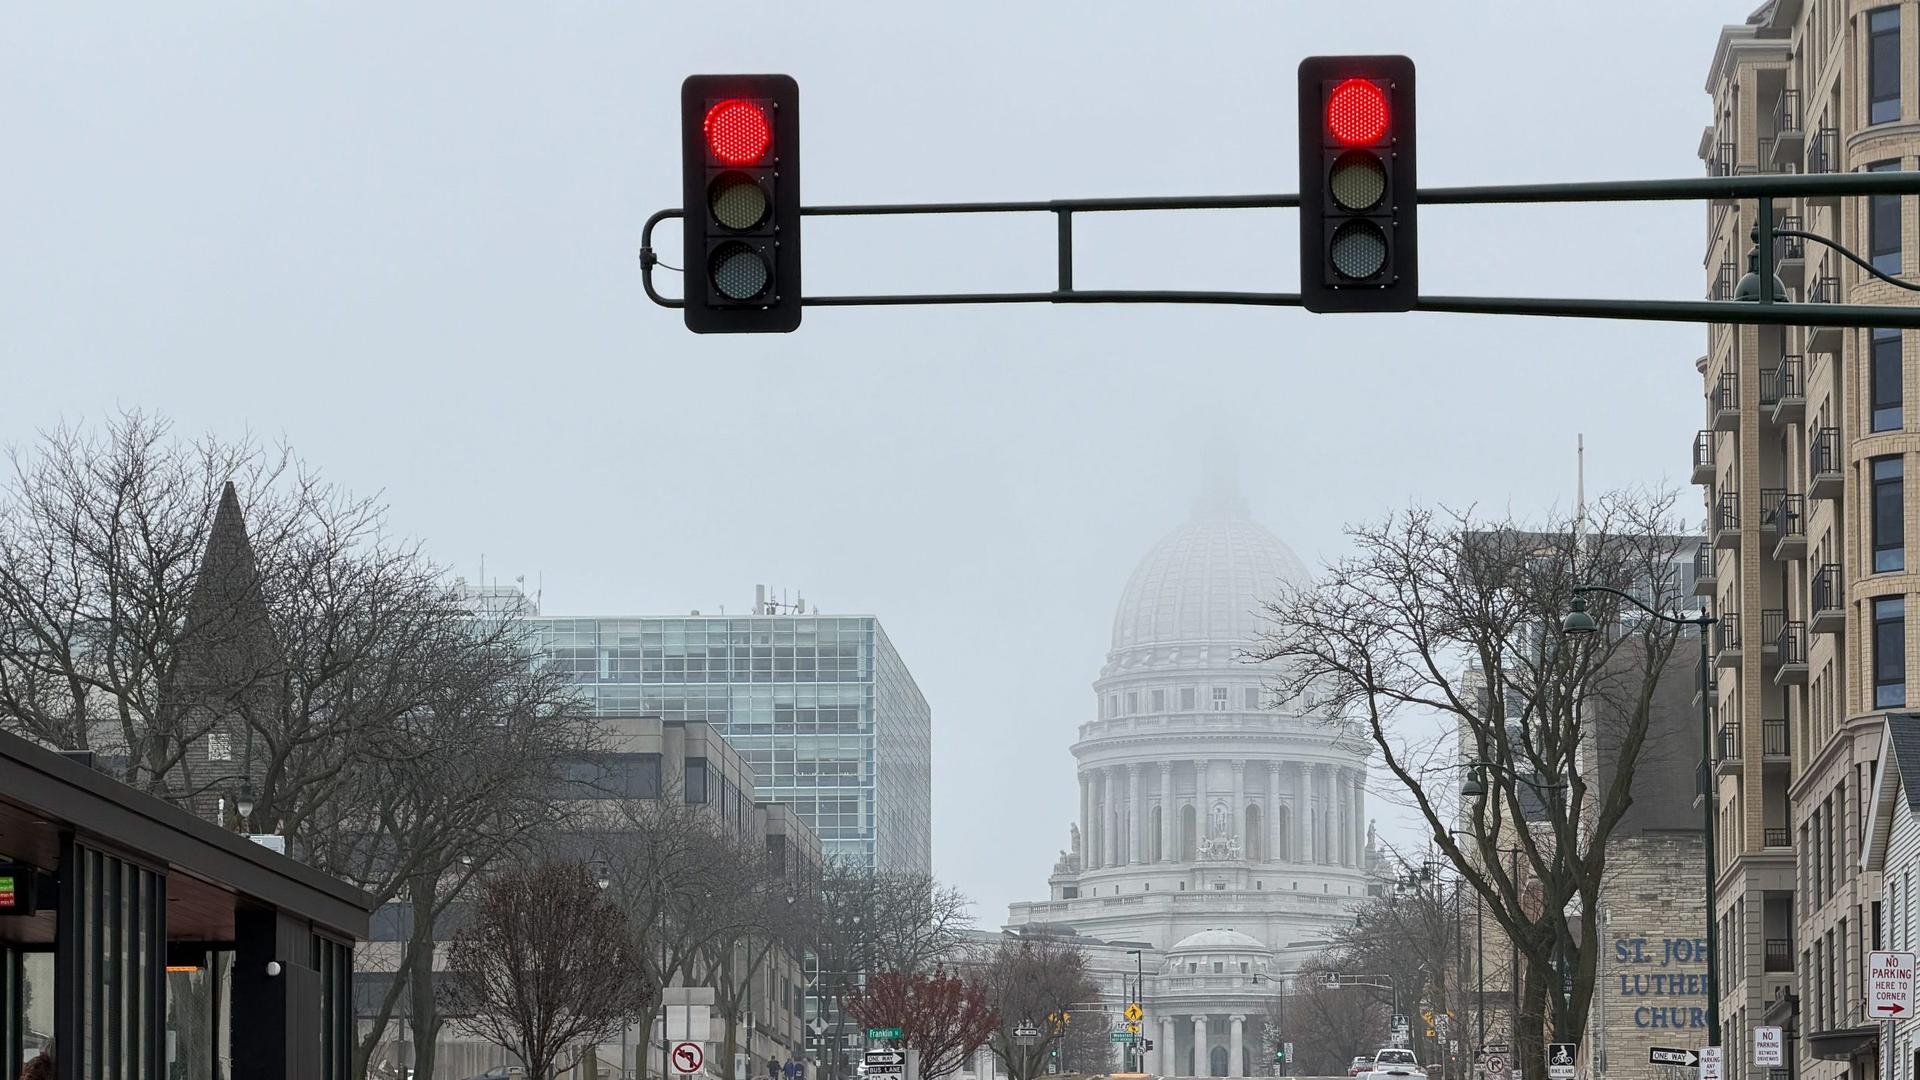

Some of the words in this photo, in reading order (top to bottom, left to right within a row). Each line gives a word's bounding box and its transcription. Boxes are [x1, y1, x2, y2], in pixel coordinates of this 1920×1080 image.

[1615, 938, 1652, 963] ST.
[1886, 957, 1898, 968] NO
[1872, 968, 1912, 979] PARKING
[1875, 981, 1896, 990] HERE
[1898, 981, 1908, 990] TO
[1876, 991, 1906, 1001] CORNER
[1634, 1006, 1709, 1028] CHUR
[869, 1029, 893, 1038] Franklin
[1762, 1031, 1774, 1041] NO
[1756, 1041, 1780, 1049] PARKING
[1654, 1051, 1669, 1060] ONE
[1671, 1052, 1687, 1061] WAY
[1706, 1049, 1715, 1057] NO
